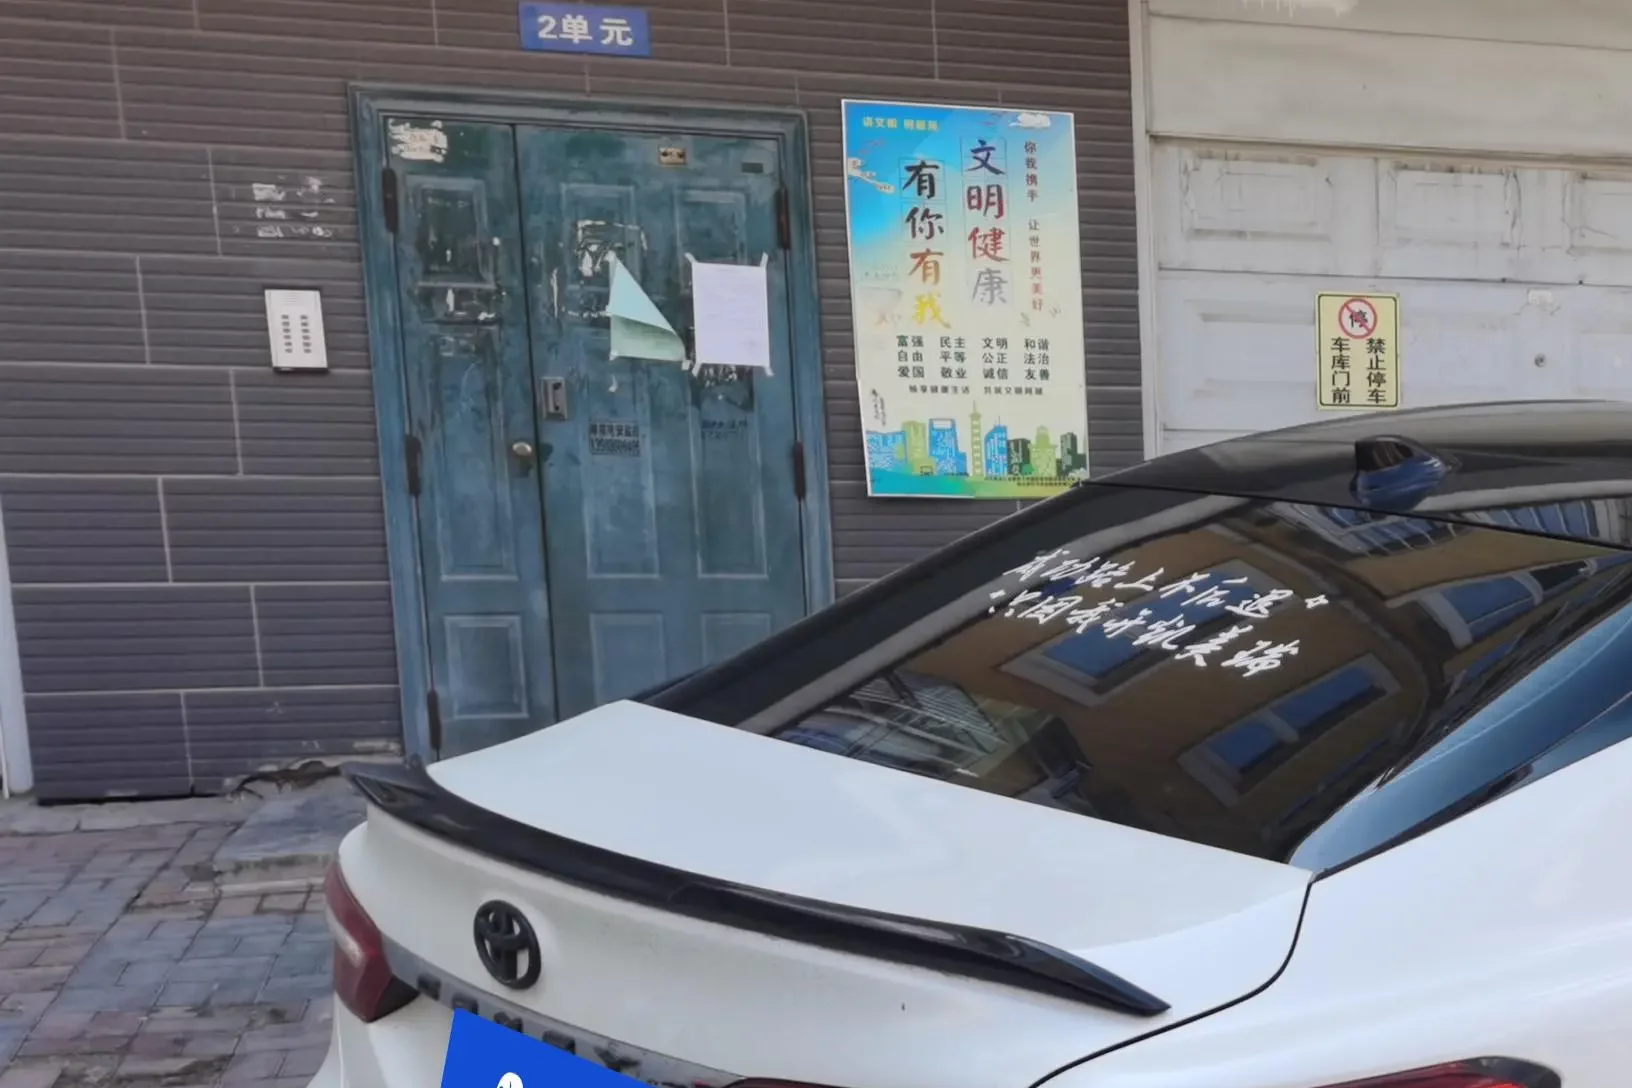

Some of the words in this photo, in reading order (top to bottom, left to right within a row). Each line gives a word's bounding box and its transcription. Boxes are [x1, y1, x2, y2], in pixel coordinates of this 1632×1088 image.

[537, 14, 633, 46] 2单元
[902, 160, 952, 329] 有你有我
[966, 139, 1010, 305] 文明健康
[896, 335, 924, 348] 富强
[940, 336, 966, 349] 民主
[982, 337, 1008, 350] 文明
[1024, 338, 1049, 350] 和谐
[897, 350, 924, 362] 自由
[940, 351, 966, 363] 平等
[982, 352, 1008, 364] 公正
[1024, 353, 1049, 365] 法治
[898, 366, 925, 379] 爱国
[941, 367, 967, 379] 敬业
[983, 368, 1008, 380] 诚信
[1025, 369, 1049, 381] 友善
[1331, 337, 1350, 404] 车库门前
[1366, 338, 1386, 404] 禁止停车
